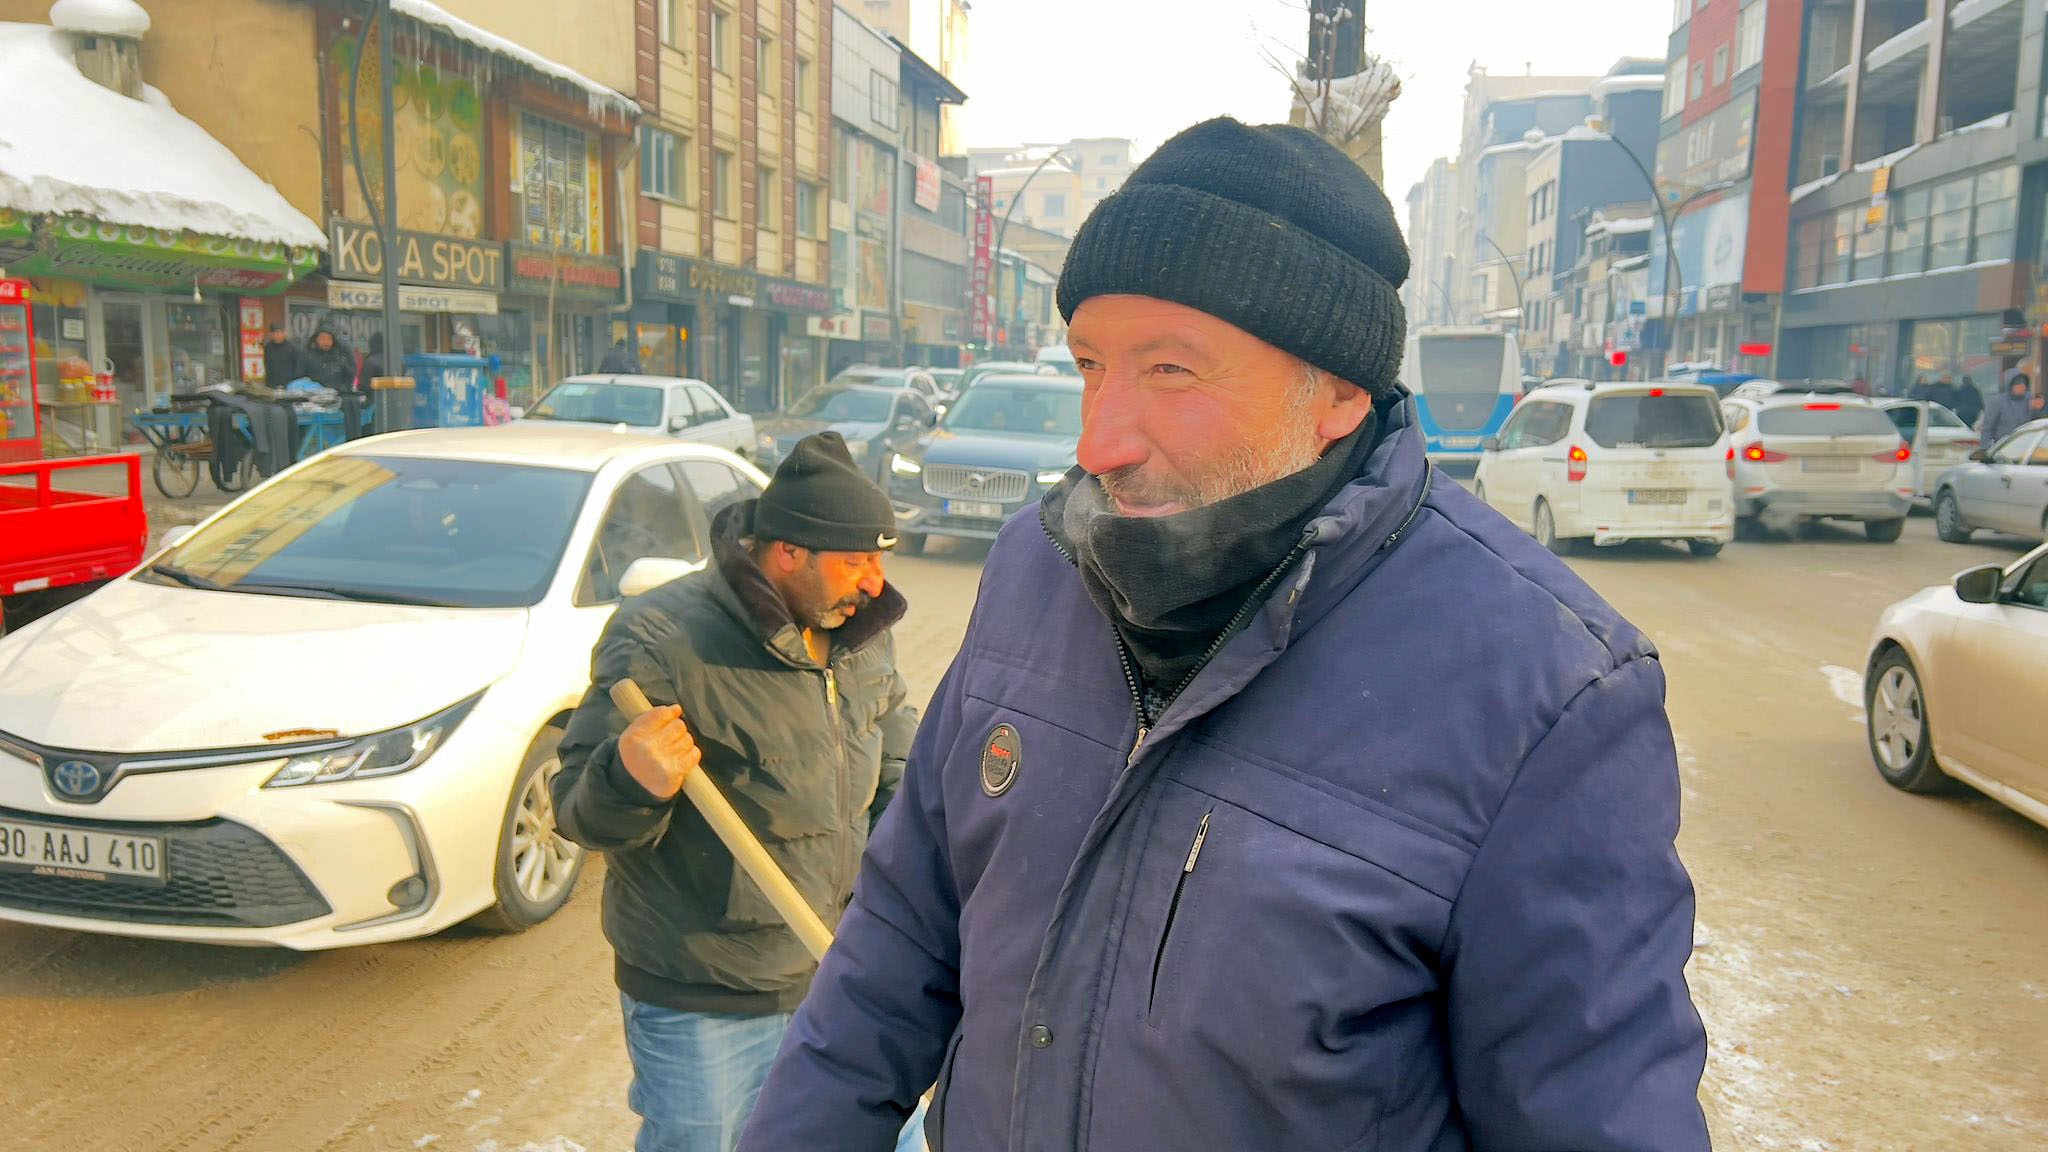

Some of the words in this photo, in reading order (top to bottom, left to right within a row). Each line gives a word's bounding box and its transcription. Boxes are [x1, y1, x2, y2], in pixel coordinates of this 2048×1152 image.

[336, 226, 425, 278] KOA
[432, 239, 500, 287] SPOT
[340, 291, 384, 306] KOZ
[405, 295, 449, 308] SPOT
[43, 832, 90, 864] AAJ
[108, 839, 156, 871] 410
